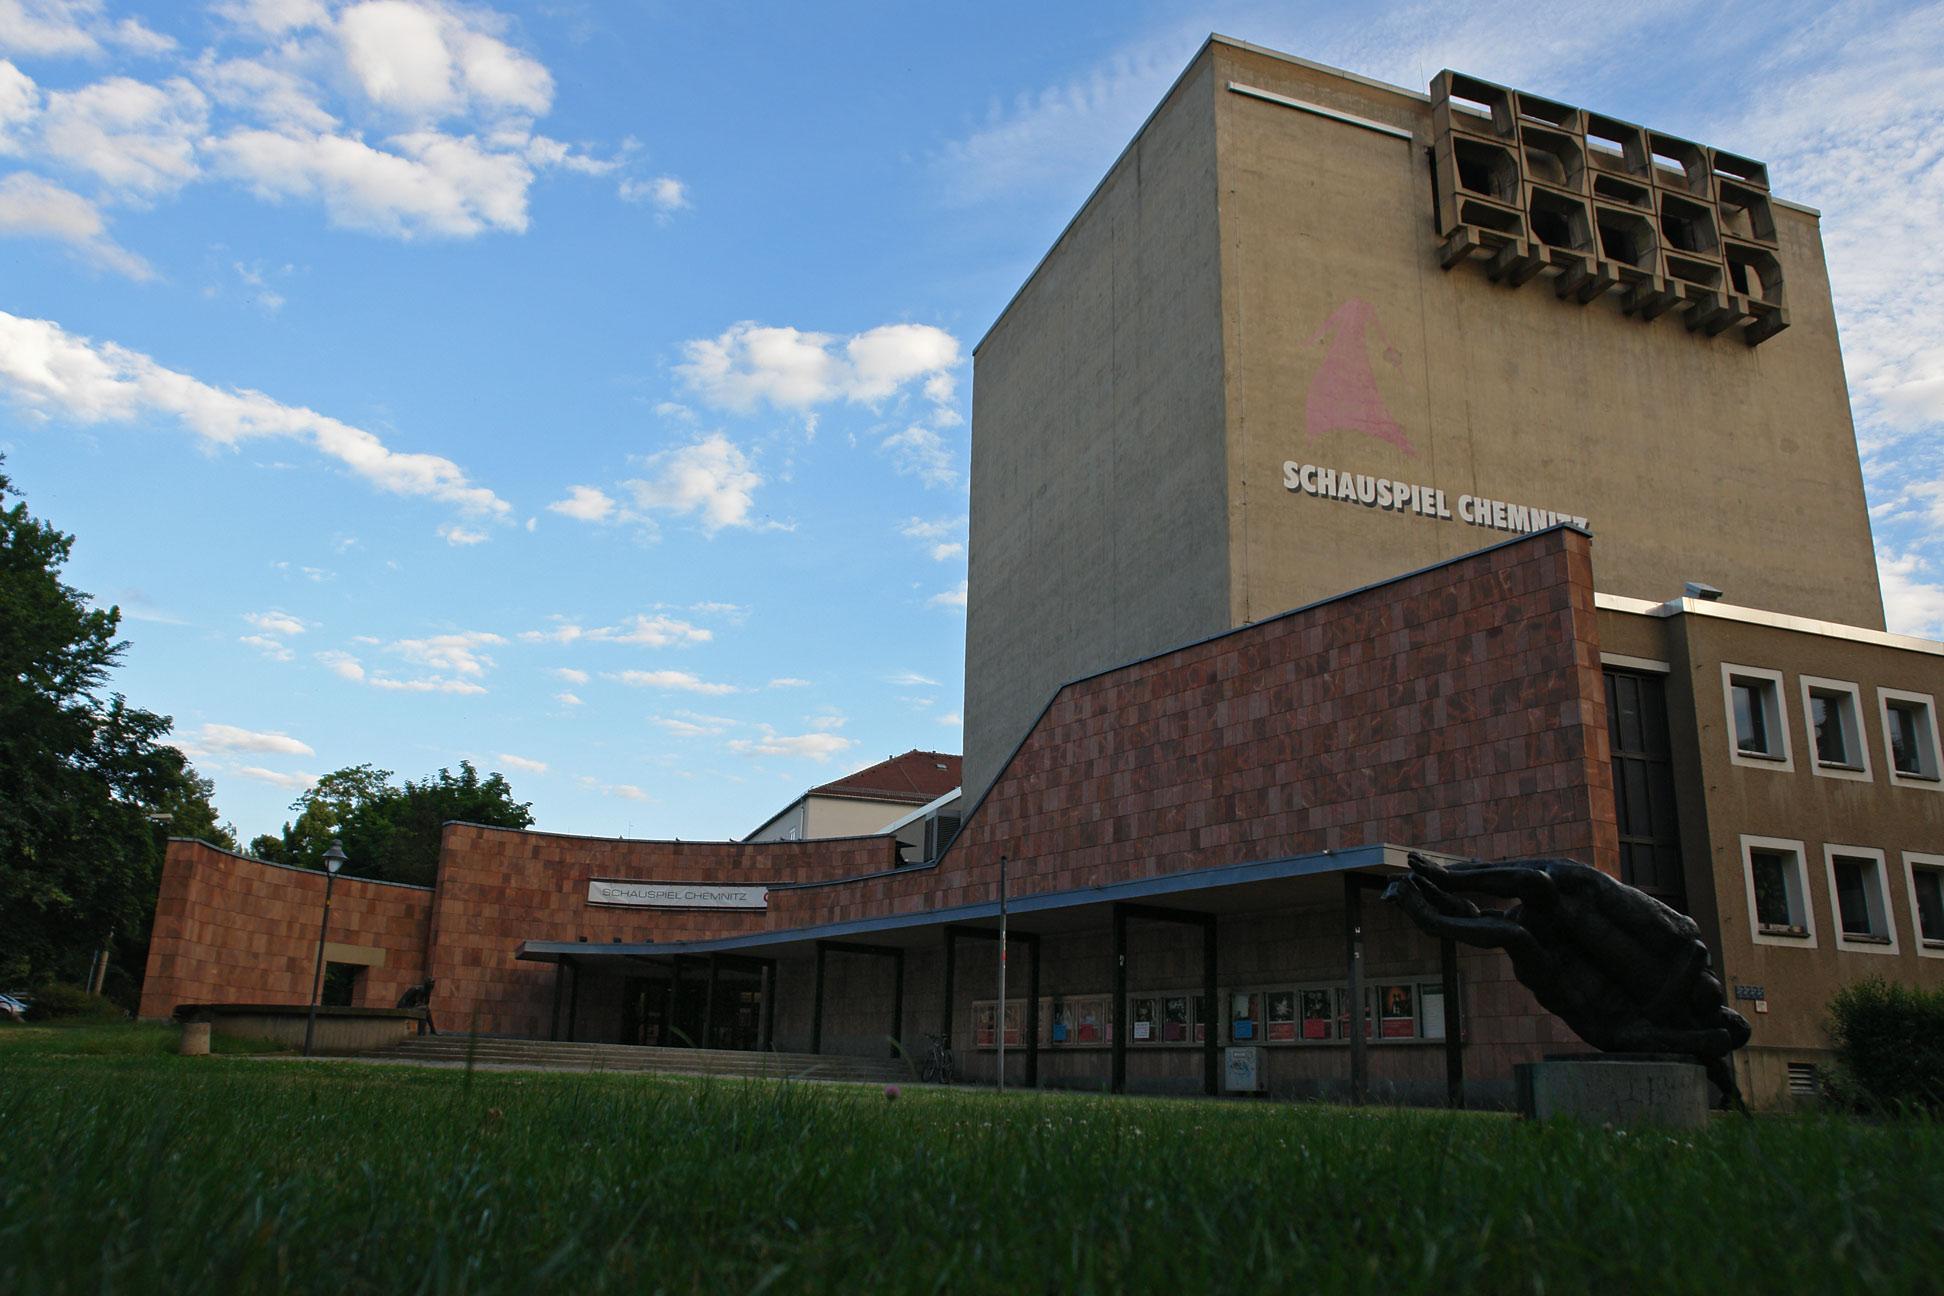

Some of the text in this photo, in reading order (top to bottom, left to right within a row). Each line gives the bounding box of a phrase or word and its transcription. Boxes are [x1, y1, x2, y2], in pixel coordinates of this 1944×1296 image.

[1283, 460, 1451, 518] SCHAUSPIEL
[602, 888, 747, 901] SCHAUSPIEL CHEMNITZ
